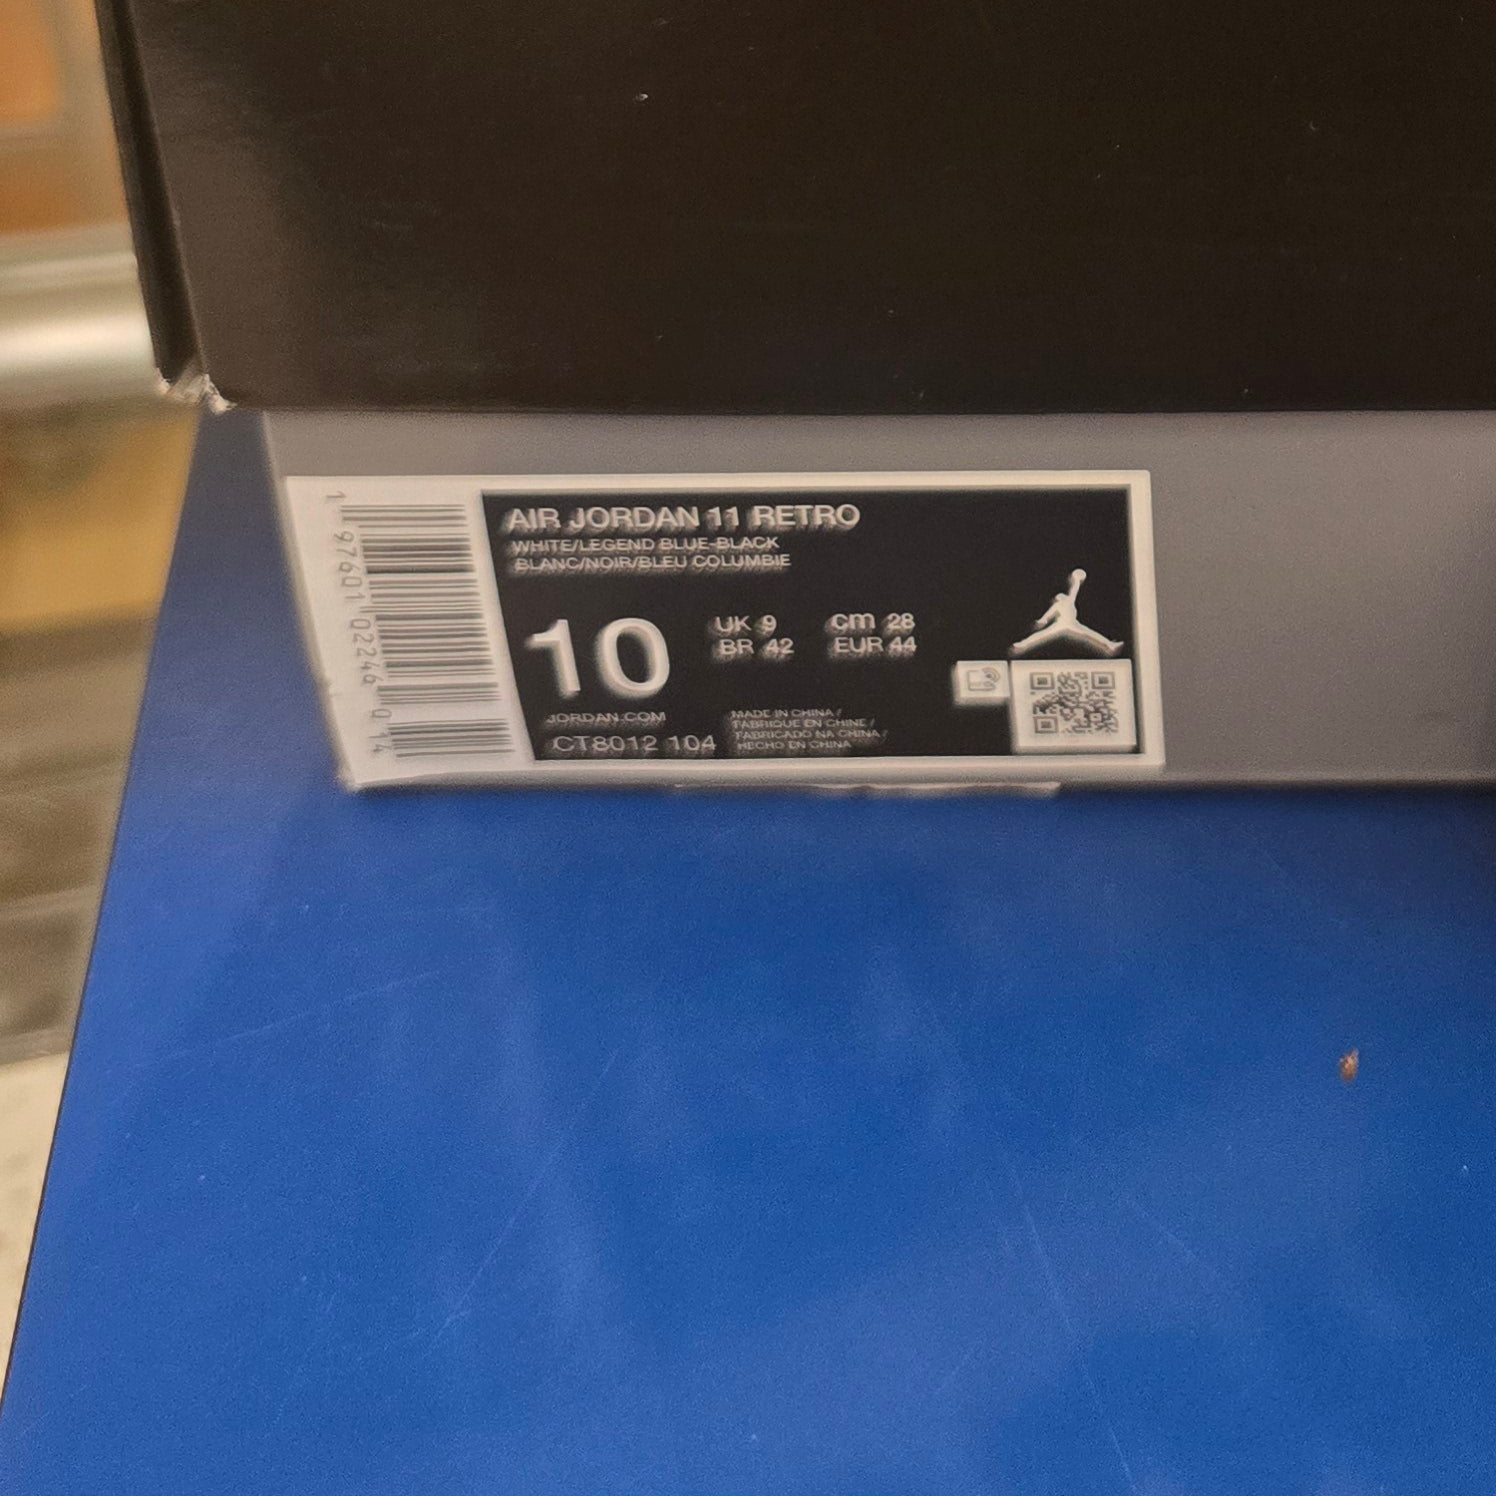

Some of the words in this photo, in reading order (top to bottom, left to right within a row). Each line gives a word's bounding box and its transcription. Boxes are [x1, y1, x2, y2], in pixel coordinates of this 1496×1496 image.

[508, 507, 560, 533] AIR
[566, 506, 700, 532] JORDAN
[706, 506, 740, 527] 11
[752, 503, 861, 527] RETRO
[513, 538, 655, 553] WHITE/LEGEND
[659, 536, 780, 551] BLUE-BLACK
[515, 557, 688, 571] BLANC/NOIR/BLEU
[717, 615, 752, 632] UK
[762, 614, 777, 631] 9
[832, 612, 876, 631] cm
[886, 612, 916, 630] 28
[719, 639, 754, 656] BR
[766, 637, 795, 655] 42
[834, 636, 884, 654] EUR
[889, 635, 918, 653] 44
[530, 617, 670, 695] 10
[547, 711, 667, 724] JORDAN.COM
[553, 735, 659, 752] CT8012
[668, 734, 718, 751] 104
